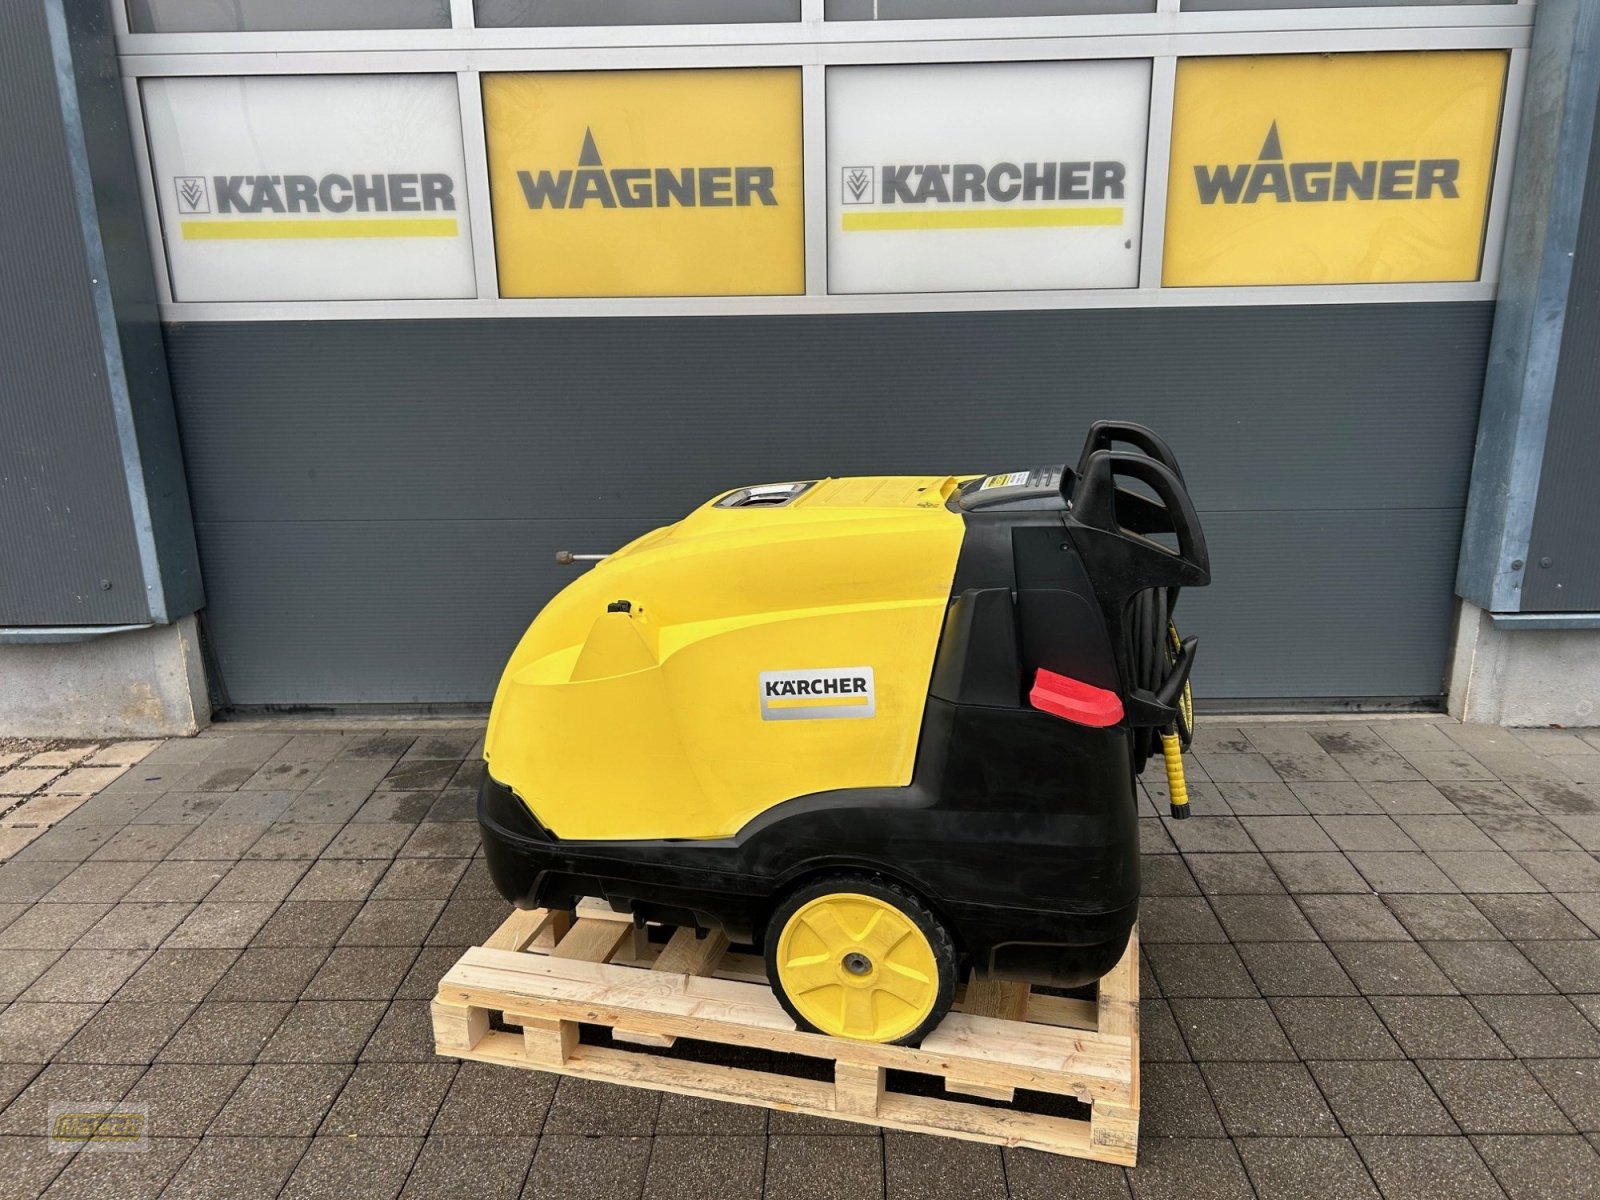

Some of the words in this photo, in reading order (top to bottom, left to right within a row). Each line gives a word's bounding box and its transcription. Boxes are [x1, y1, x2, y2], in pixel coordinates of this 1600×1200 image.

[213, 173, 456, 213] KÄRCHER
[516, 165, 779, 210] WAGNER
[881, 160, 1126, 204] KÄRCHER
[1193, 158, 1460, 205] WAGNER
[765, 677, 867, 696] KÄRCHER
